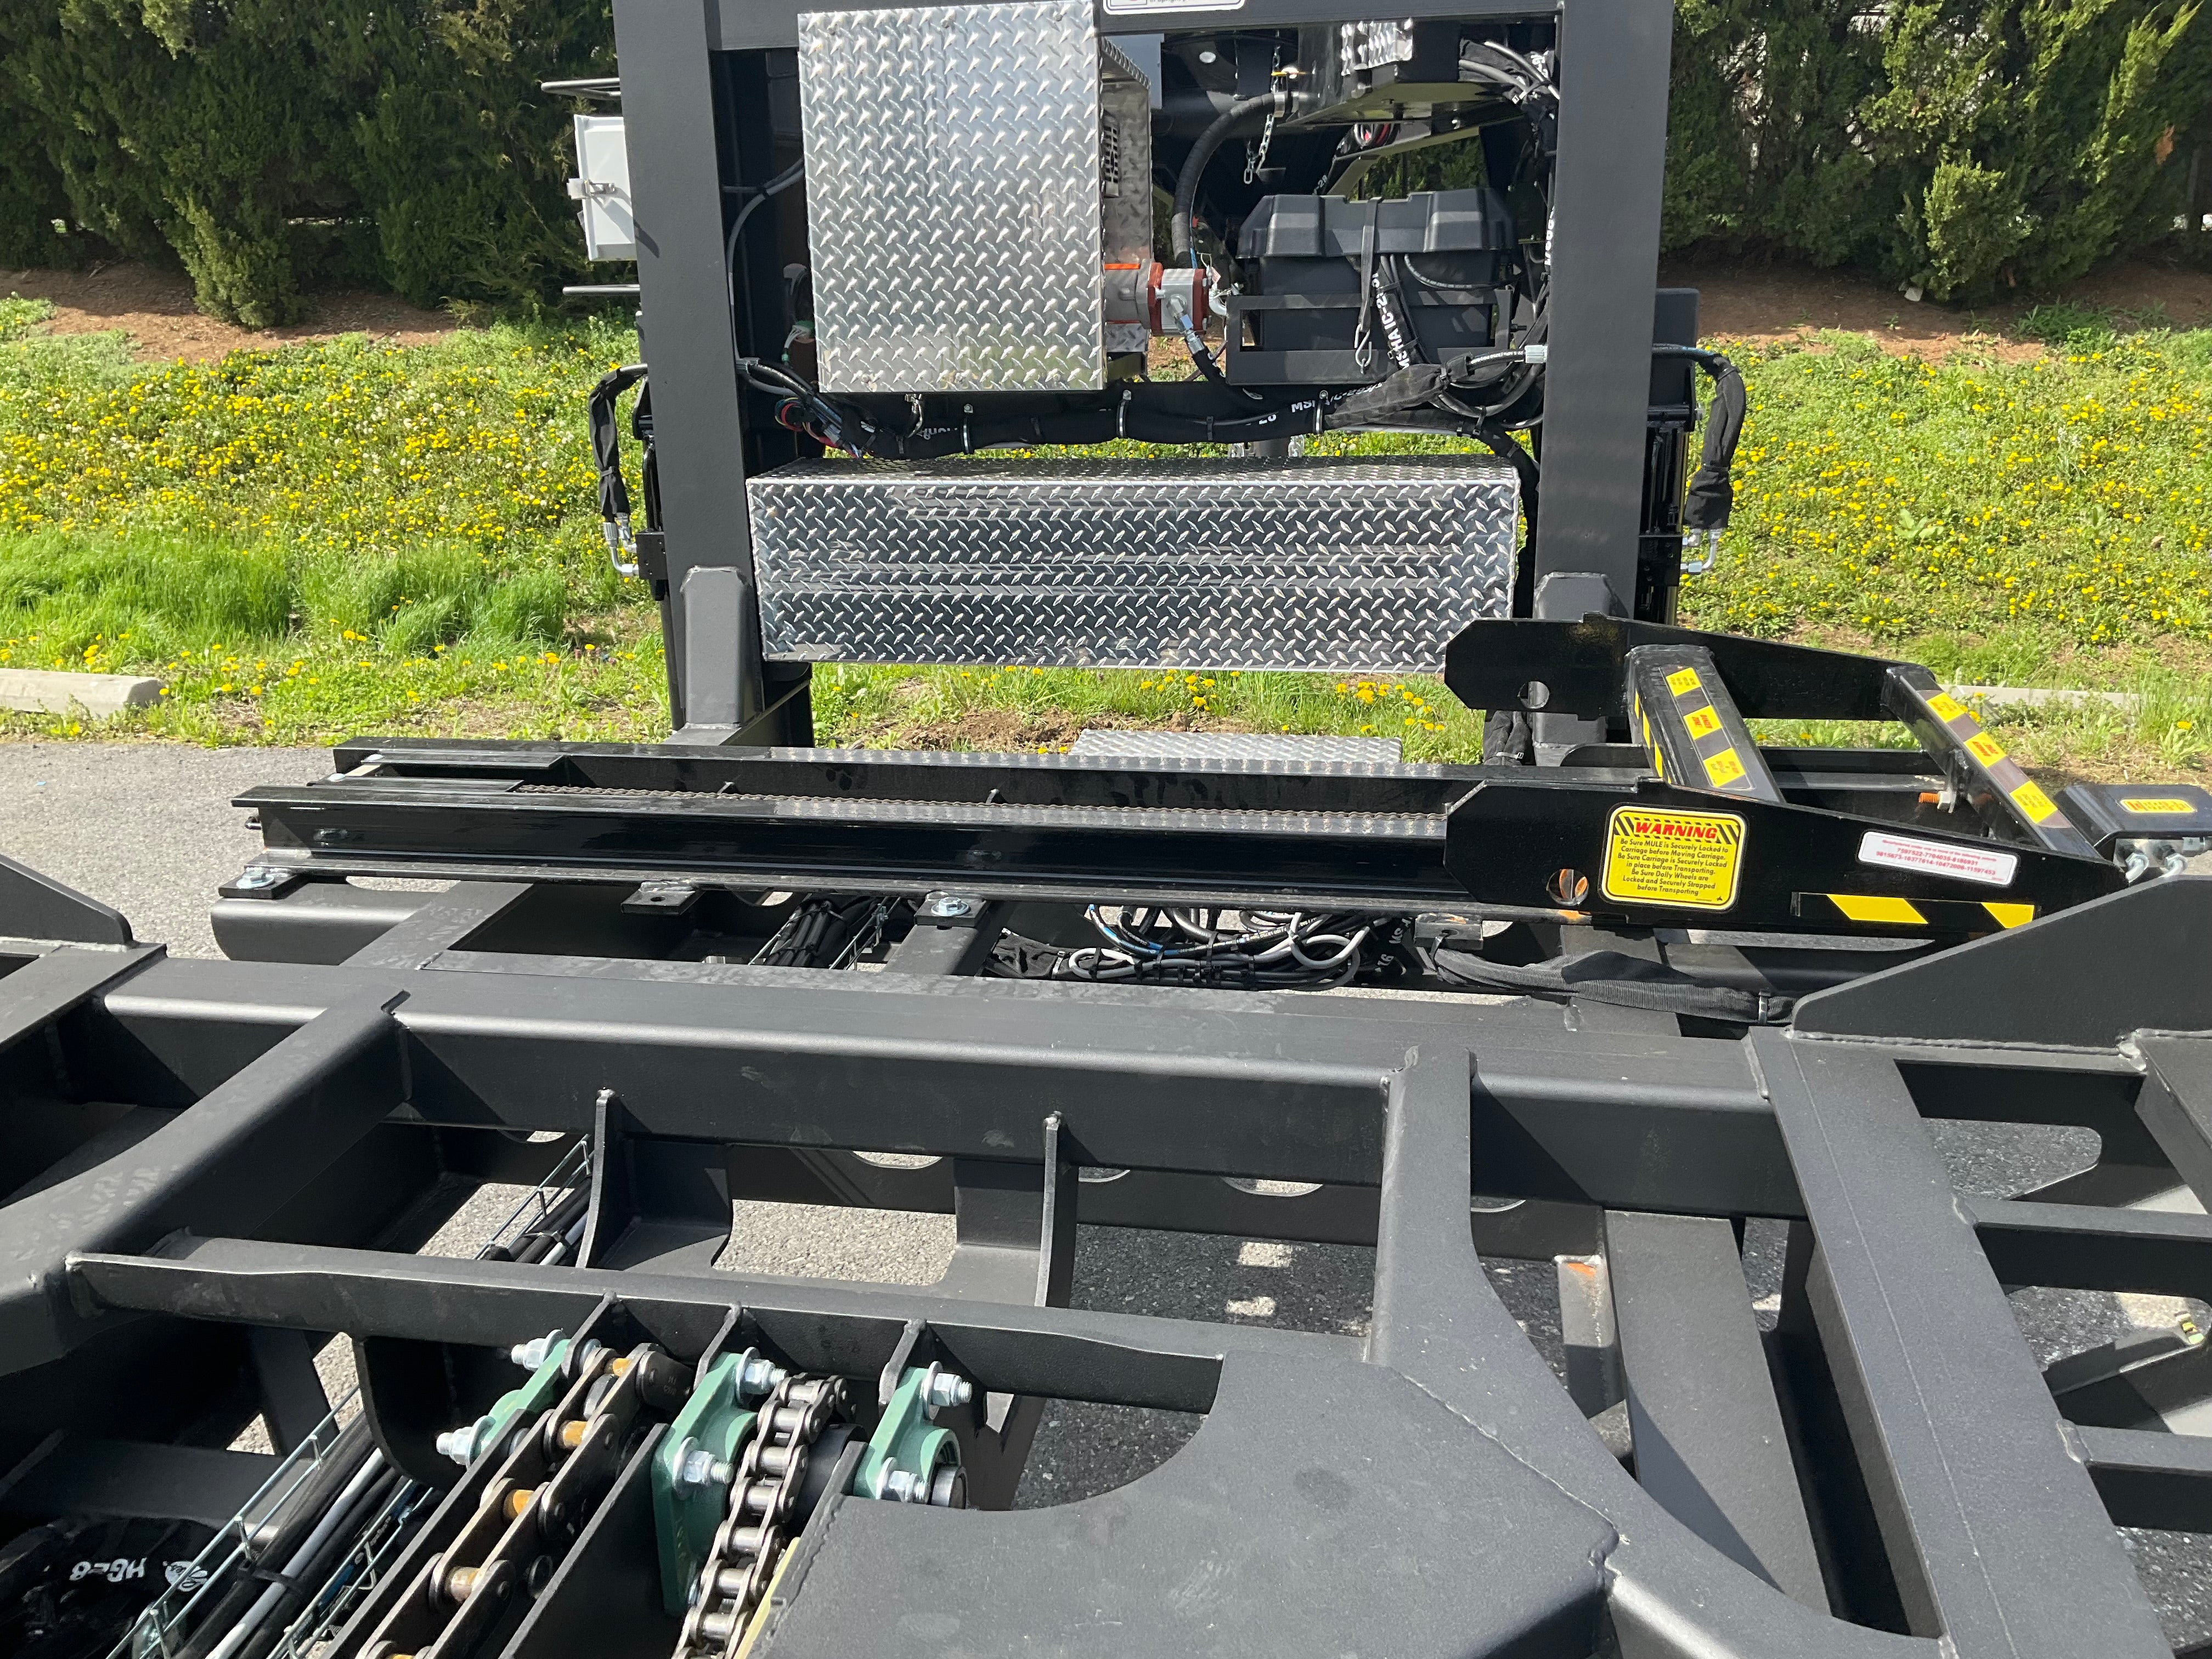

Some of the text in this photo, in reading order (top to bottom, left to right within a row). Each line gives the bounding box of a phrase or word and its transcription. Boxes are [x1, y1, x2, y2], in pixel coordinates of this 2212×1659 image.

[1636, 822, 1717, 839] WARNING
[1671, 843, 1697, 851] Securely
[1621, 846, 1647, 854] Carriage
[1671, 850, 1695, 859] Moving
[1697, 852, 1725, 861] Carriage.
[1642, 855, 1669, 865] Carriage
[1677, 857, 1703, 866] Securely
[1656, 871, 1673, 879] Dolly
[1674, 865, 1716, 875] Transporting.
[1660, 878, 1686, 887] Securely
[1688, 881, 1716, 889] Strapped
[1659, 886, 1699, 896] Transporting
[69, 1557, 147, 1583] HG-8
